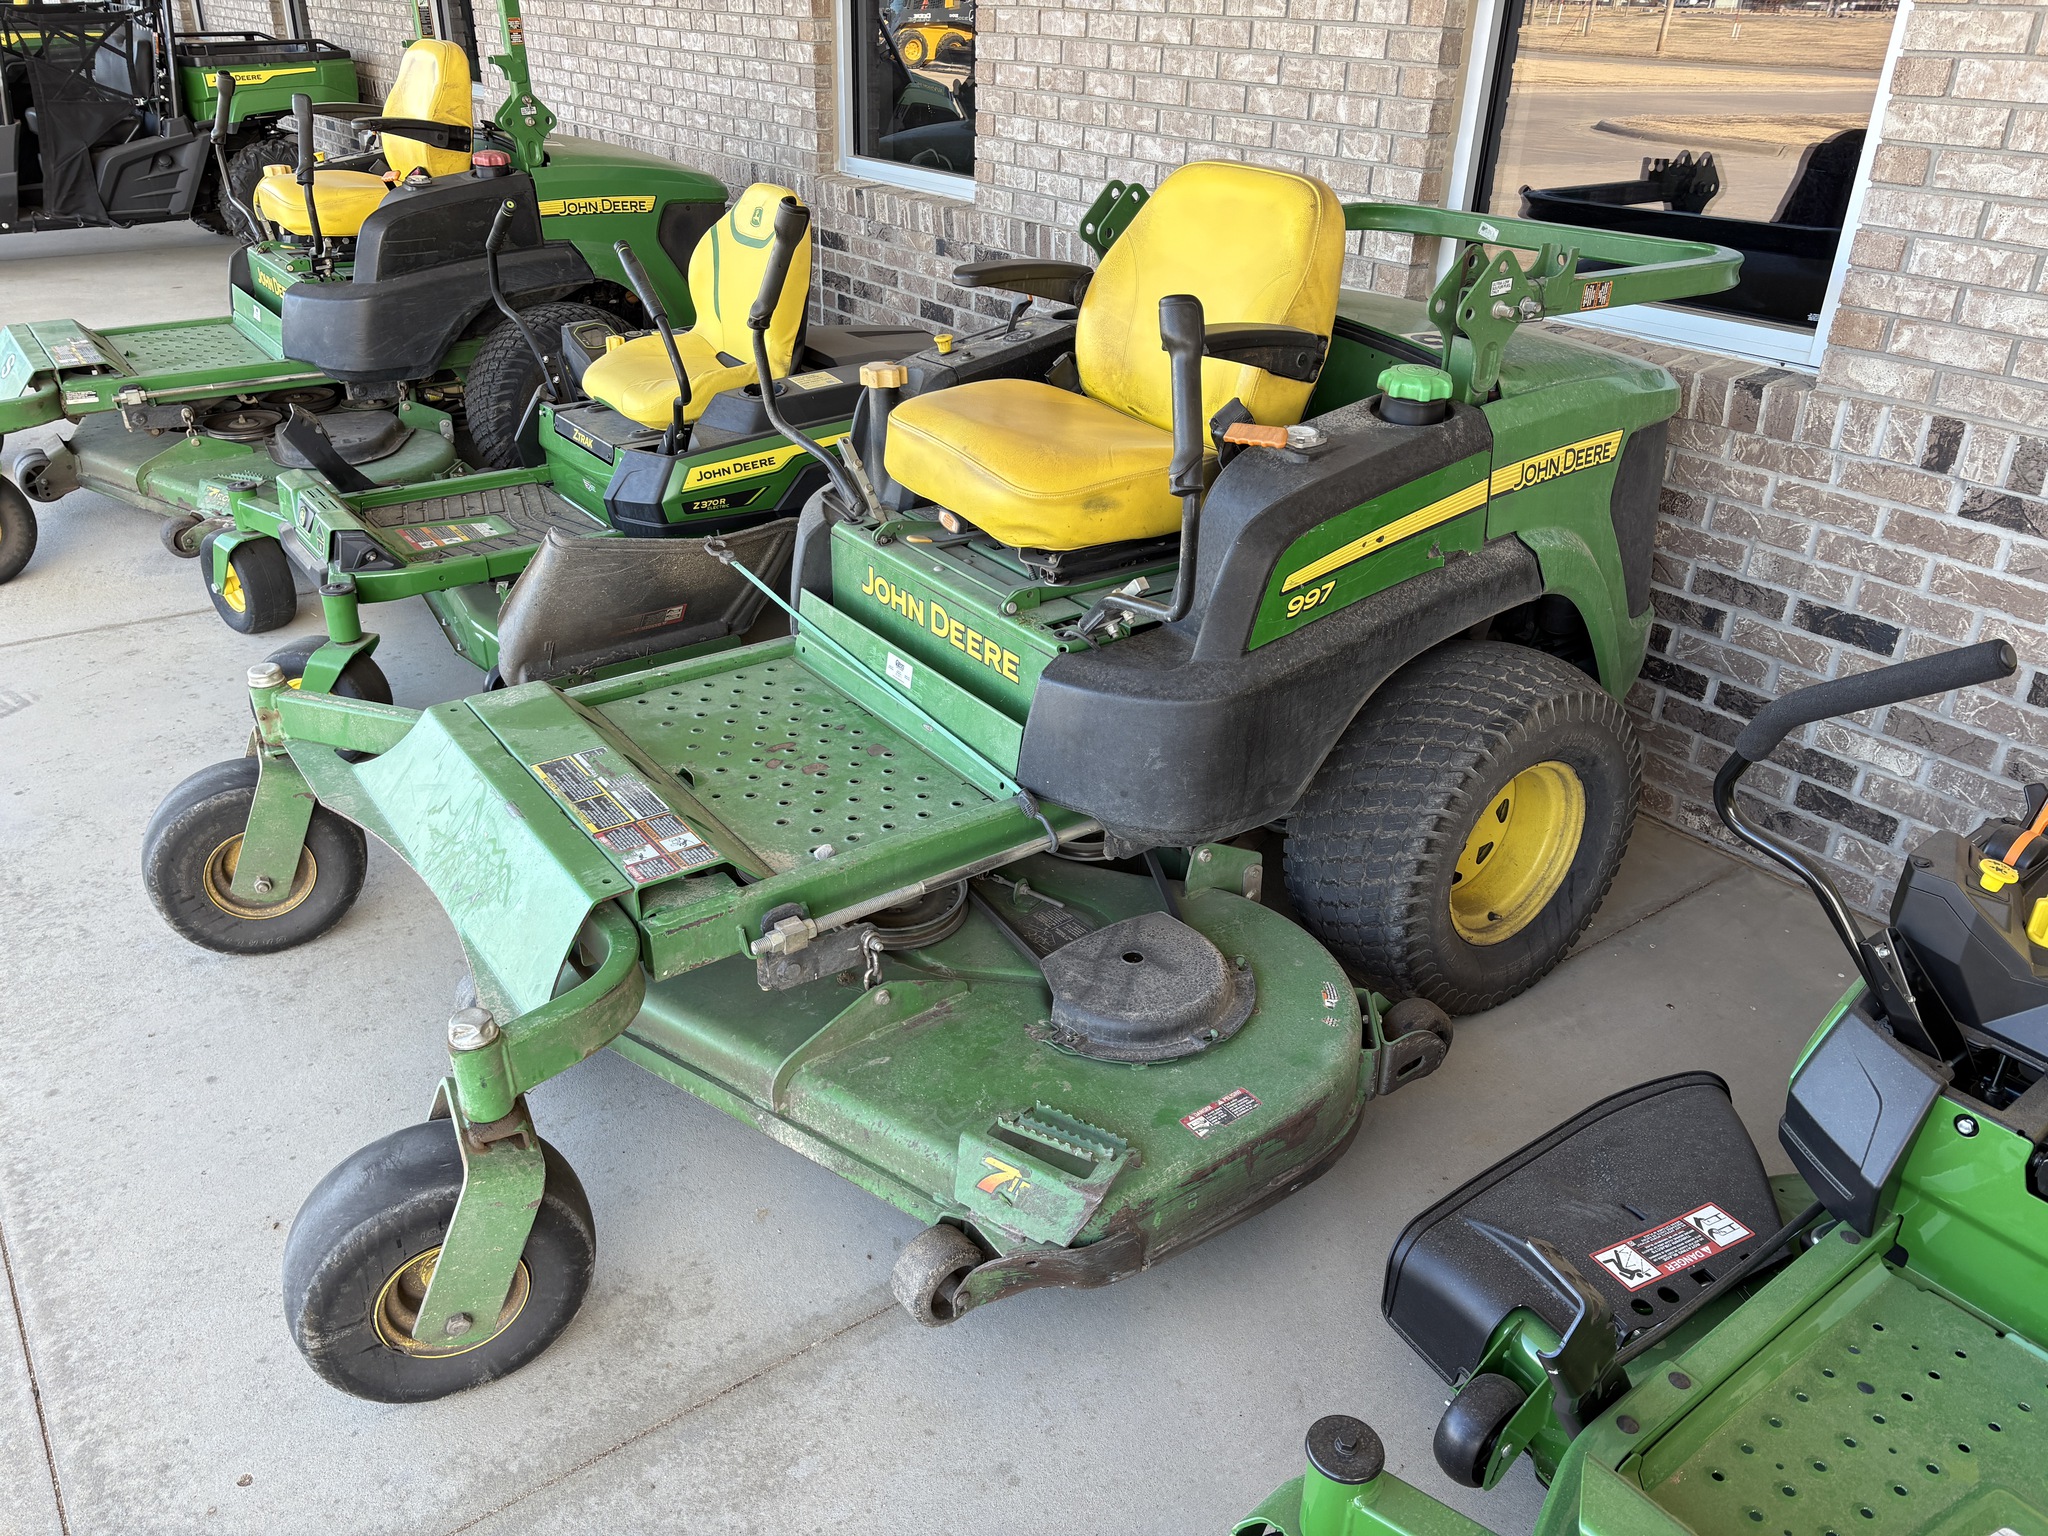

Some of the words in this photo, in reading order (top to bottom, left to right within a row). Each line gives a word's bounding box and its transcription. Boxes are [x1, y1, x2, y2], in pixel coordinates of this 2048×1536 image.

[559, 200, 599, 215] JOHN
[601, 198, 647, 213] DEERE
[696, 466, 732, 482] JOHN
[733, 456, 776, 474] DEERE
[1513, 455, 1561, 489] JOHN
[1563, 441, 1612, 472] DEERE
[1286, 579, 1337, 618] 997
[861, 564, 925, 628] JOHN
[930, 599, 1021, 686] DEERE
[1664, 1249, 1706, 1272] DANGER
